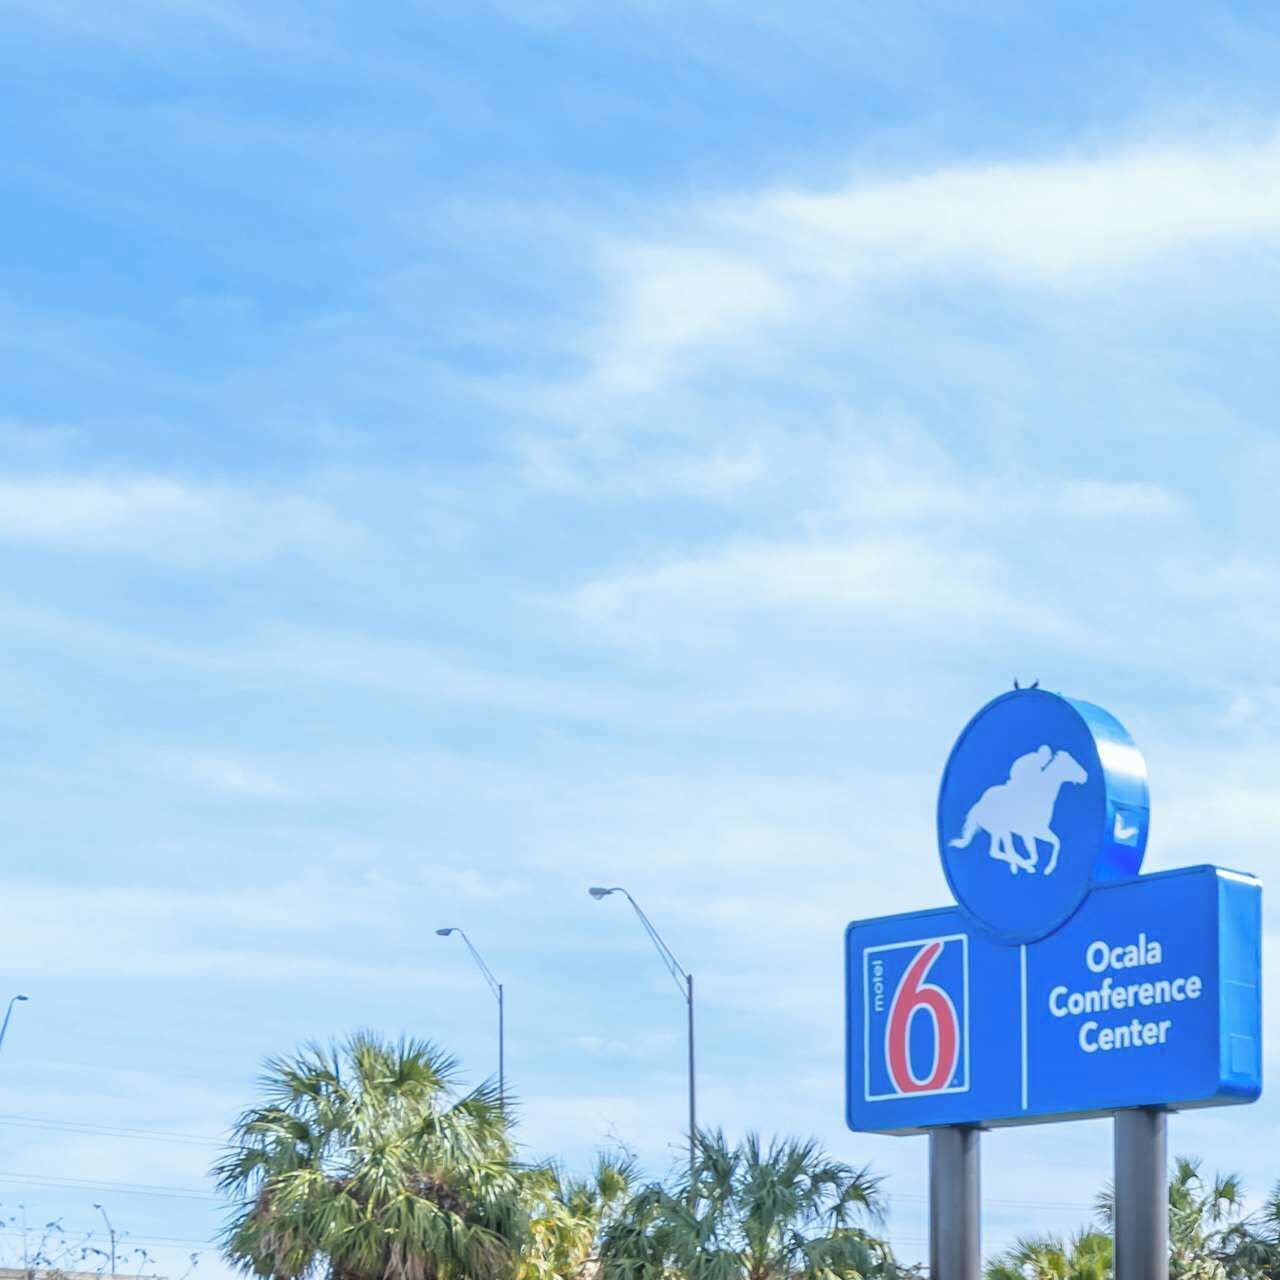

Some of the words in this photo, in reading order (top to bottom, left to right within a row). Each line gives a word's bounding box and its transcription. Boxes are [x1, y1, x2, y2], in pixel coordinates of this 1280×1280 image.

[1086, 933, 1162, 973] Ocala
[872, 960, 884, 1012] motel
[1049, 976, 1202, 1017] Conference
[885, 941, 960, 1094] 6
[1079, 1019, 1171, 1053] Center
